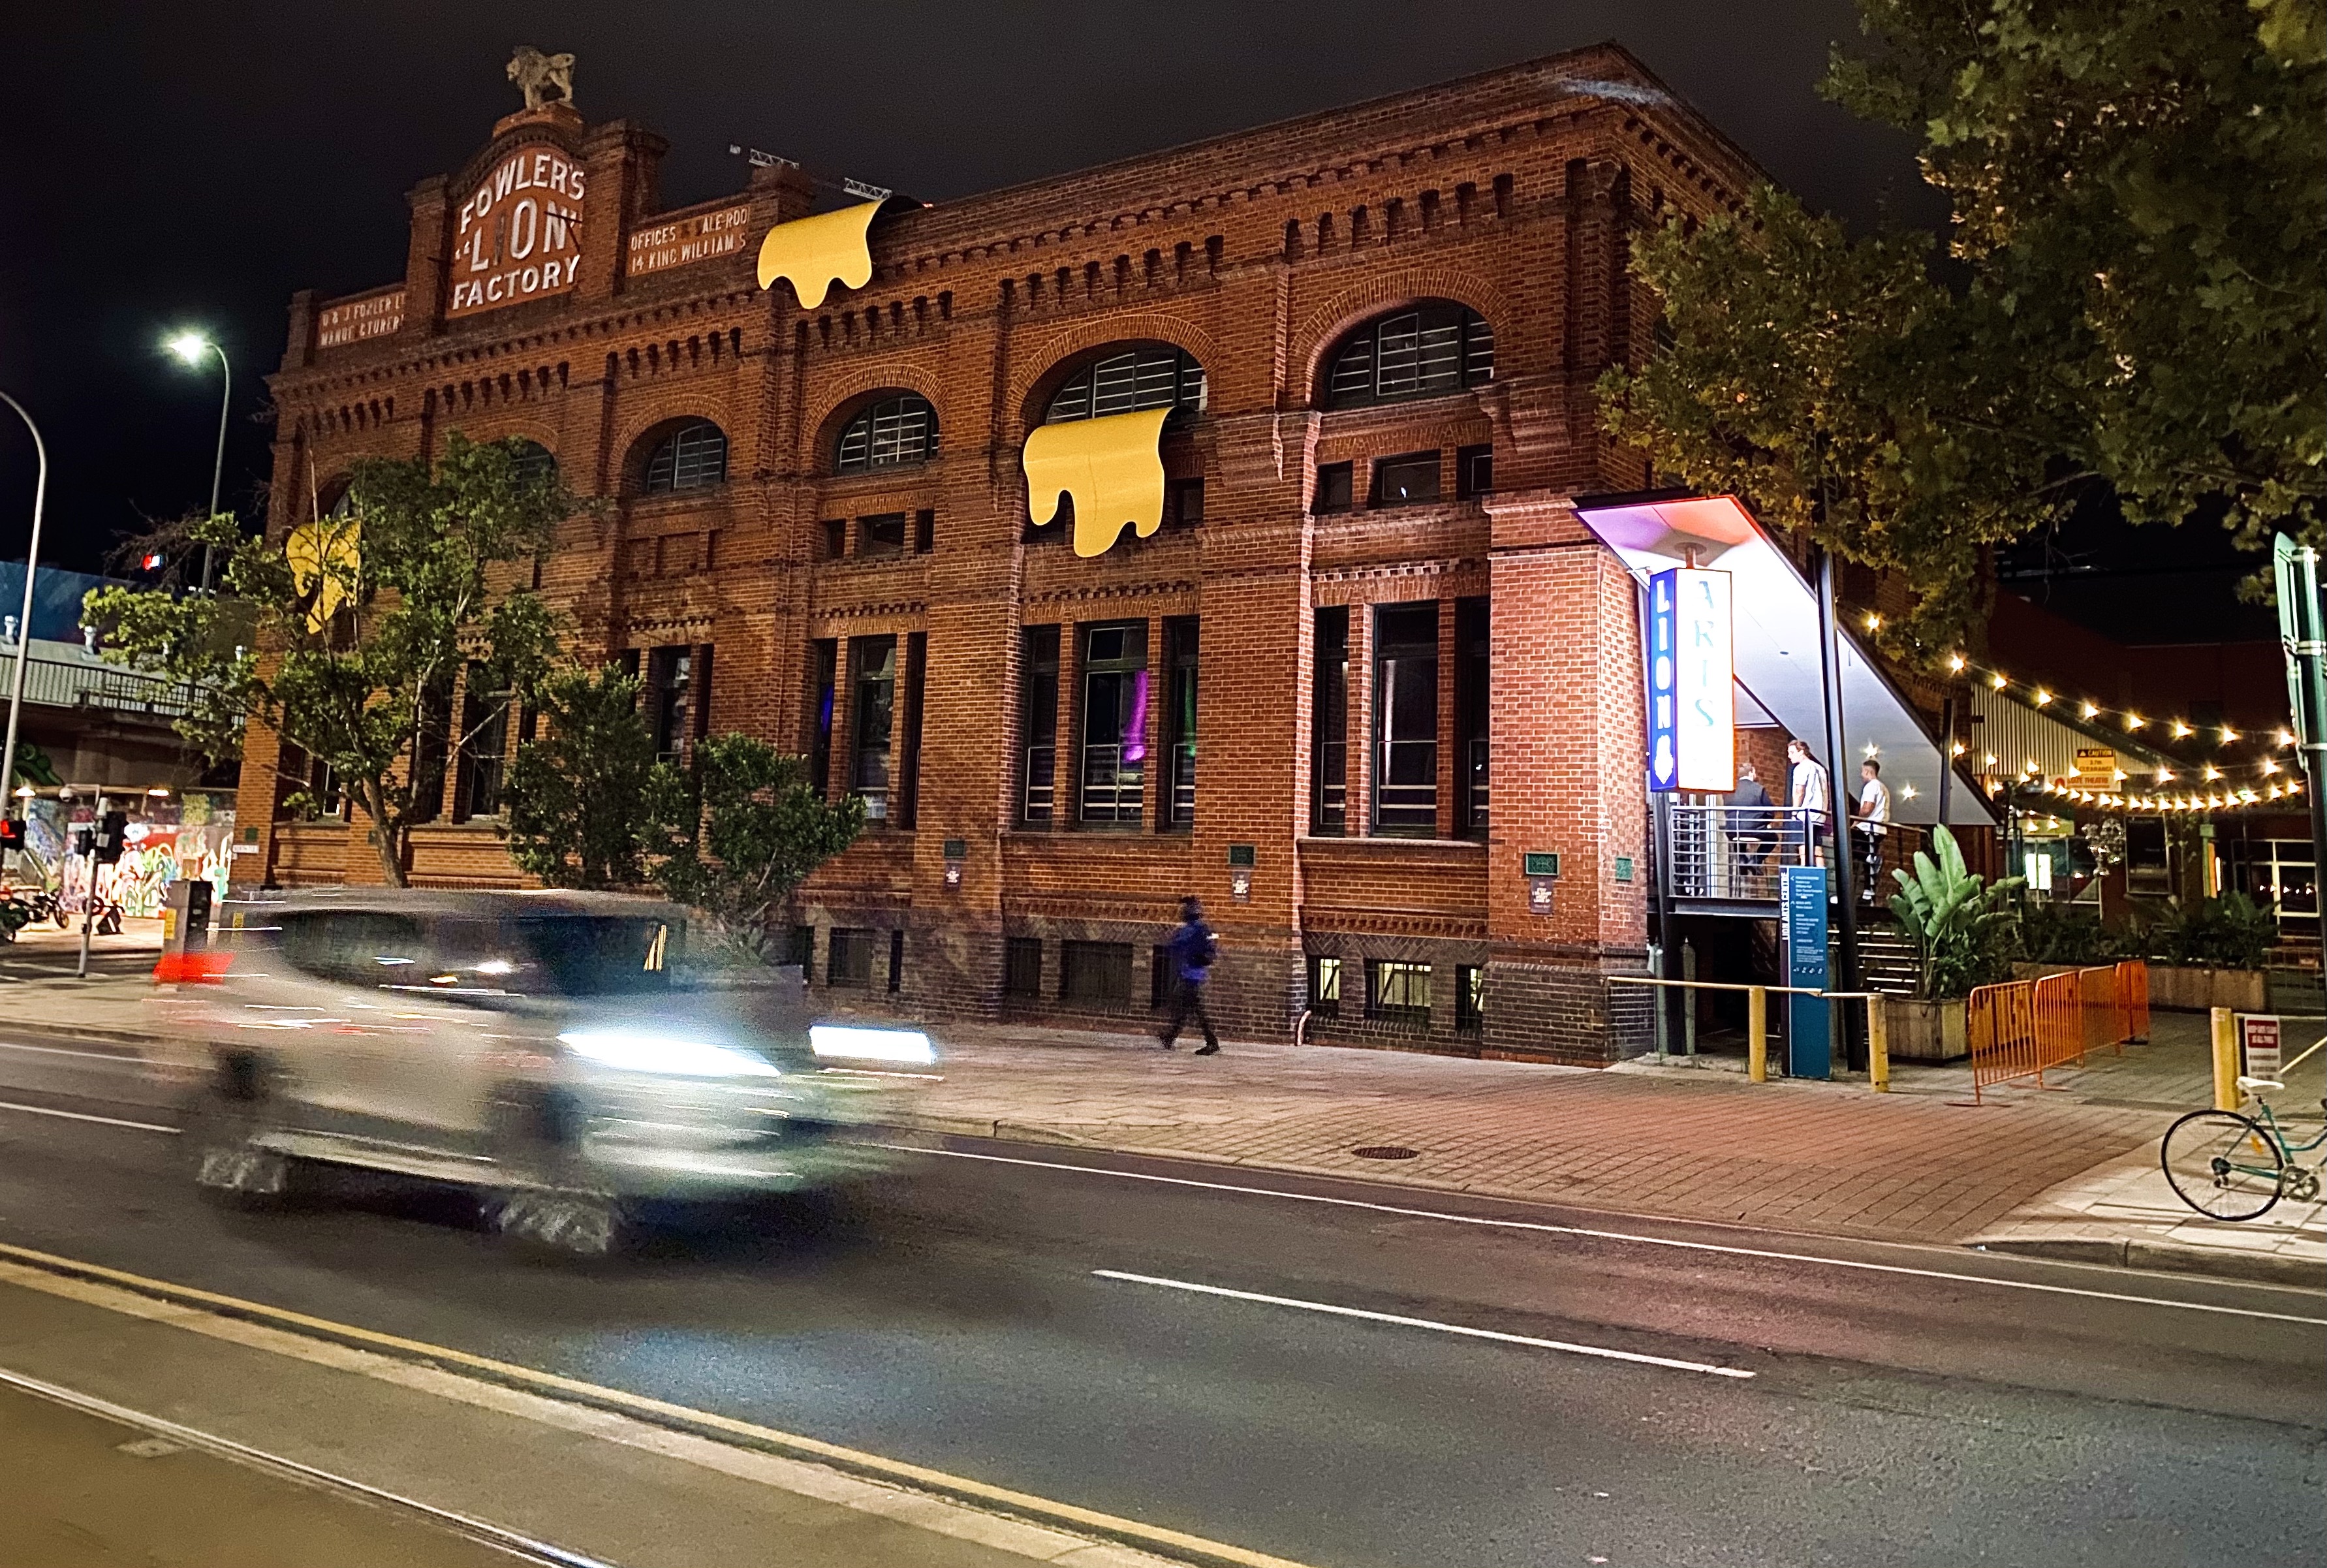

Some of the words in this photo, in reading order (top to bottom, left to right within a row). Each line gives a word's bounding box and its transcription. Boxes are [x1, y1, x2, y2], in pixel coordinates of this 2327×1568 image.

[460, 153, 584, 235] FOWLER'S
[631, 226, 676, 251] OFFICES
[632, 255, 644, 273] 14
[649, 248, 676, 269] KING
[681, 234, 734, 262] WILLIAM
[452, 254, 580, 310] FACTORY
[1656, 580, 1671, 729] LION
